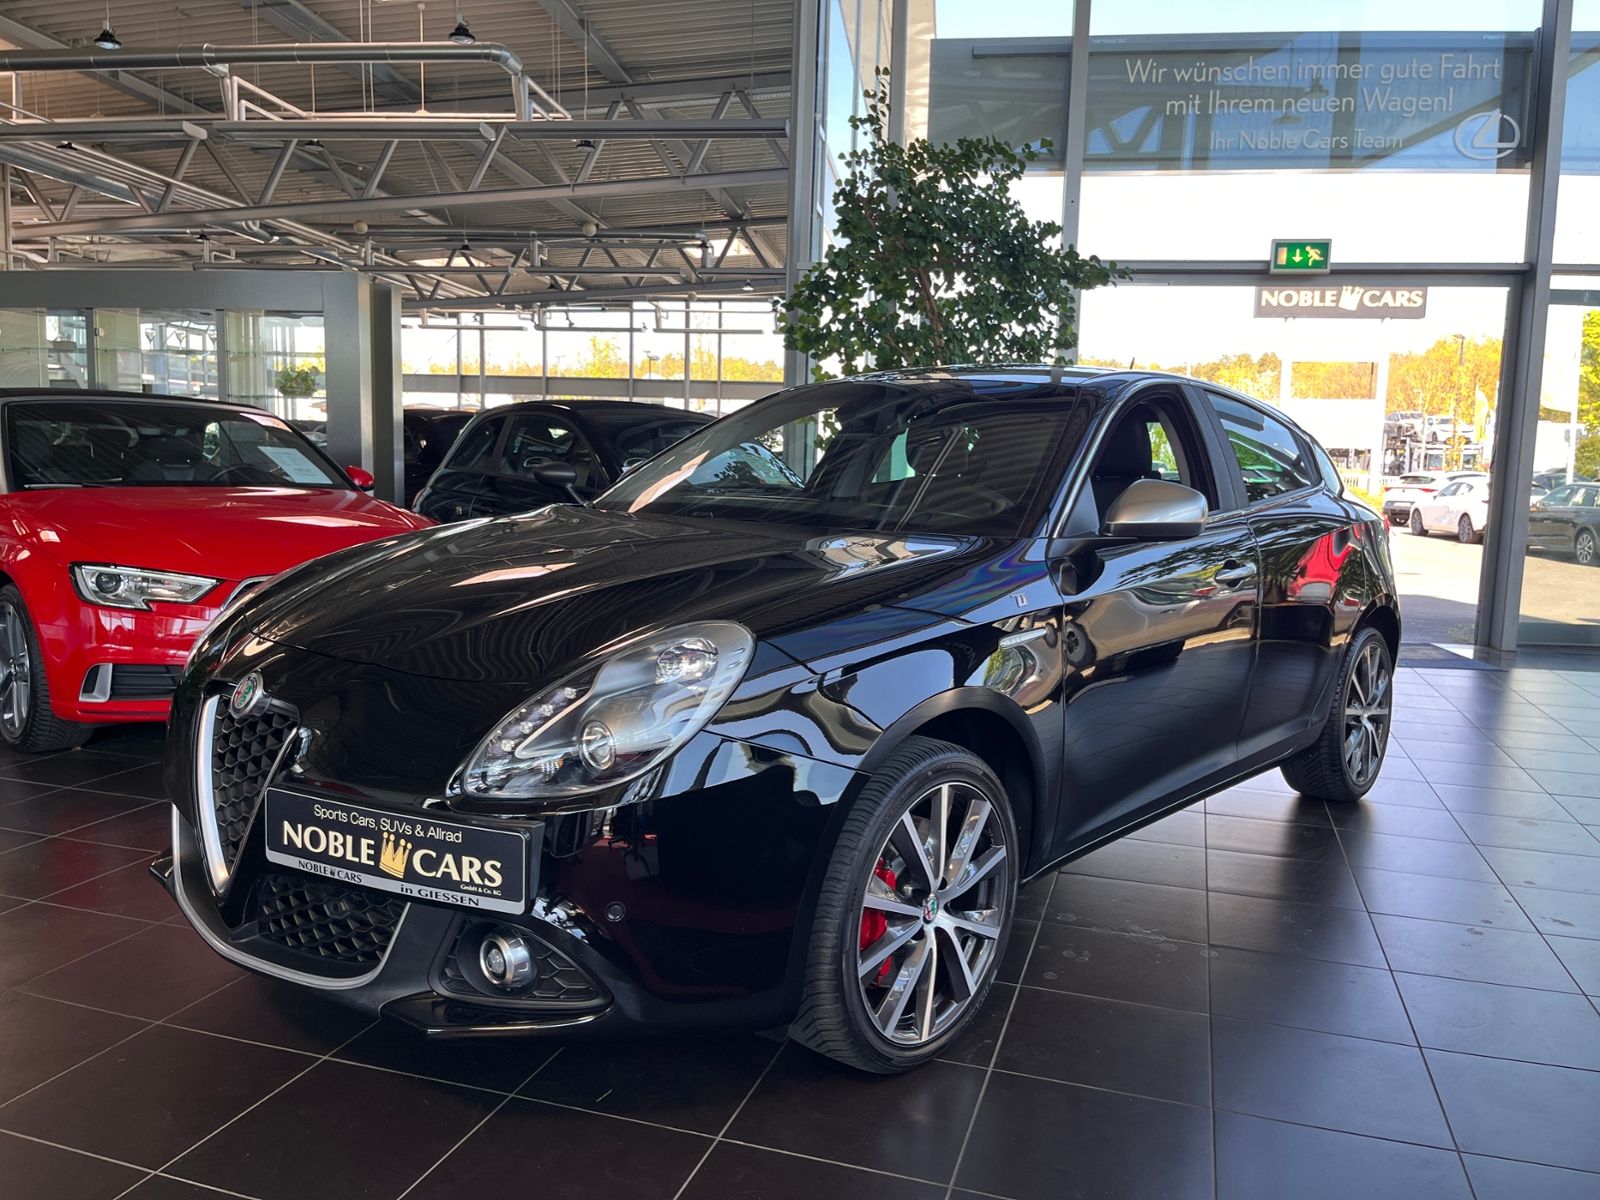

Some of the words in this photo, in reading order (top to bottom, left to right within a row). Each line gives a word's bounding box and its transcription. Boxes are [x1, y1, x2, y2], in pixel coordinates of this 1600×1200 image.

[1125, 58, 1167, 83] Wir
[1173, 56, 1290, 82] wünschen
[1298, 60, 1375, 80] immer
[1380, 57, 1433, 84] gute
[1440, 53, 1500, 79] Fahrt
[1166, 94, 1201, 115] mit
[1208, 89, 1275, 114] Ihrem
[1282, 96, 1355, 113] neuen
[1363, 86, 1453, 117] Wagen!
[1210, 130, 1233, 150] Ihr
[1240, 129, 1298, 150] Noble
[1303, 128, 1349, 149] Cars
[1354, 128, 1403, 149] Team
[1260, 290, 1338, 308] NOBLE
[1363, 290, 1423, 308] CARS
[314, 804, 348, 823] Sports
[350, 811, 379, 831] Cars,
[380, 817, 412, 835] SUVs
[414, 823, 425, 838] &
[426, 826, 463, 843] Allrad
[283, 820, 375, 866] NOBLE
[412, 848, 503, 888] CARS
[298, 860, 328, 875] NOBLE
[337, 870, 362, 884] CARS
[400, 883, 413, 894] in
[418, 887, 480, 907] GIESSEN
